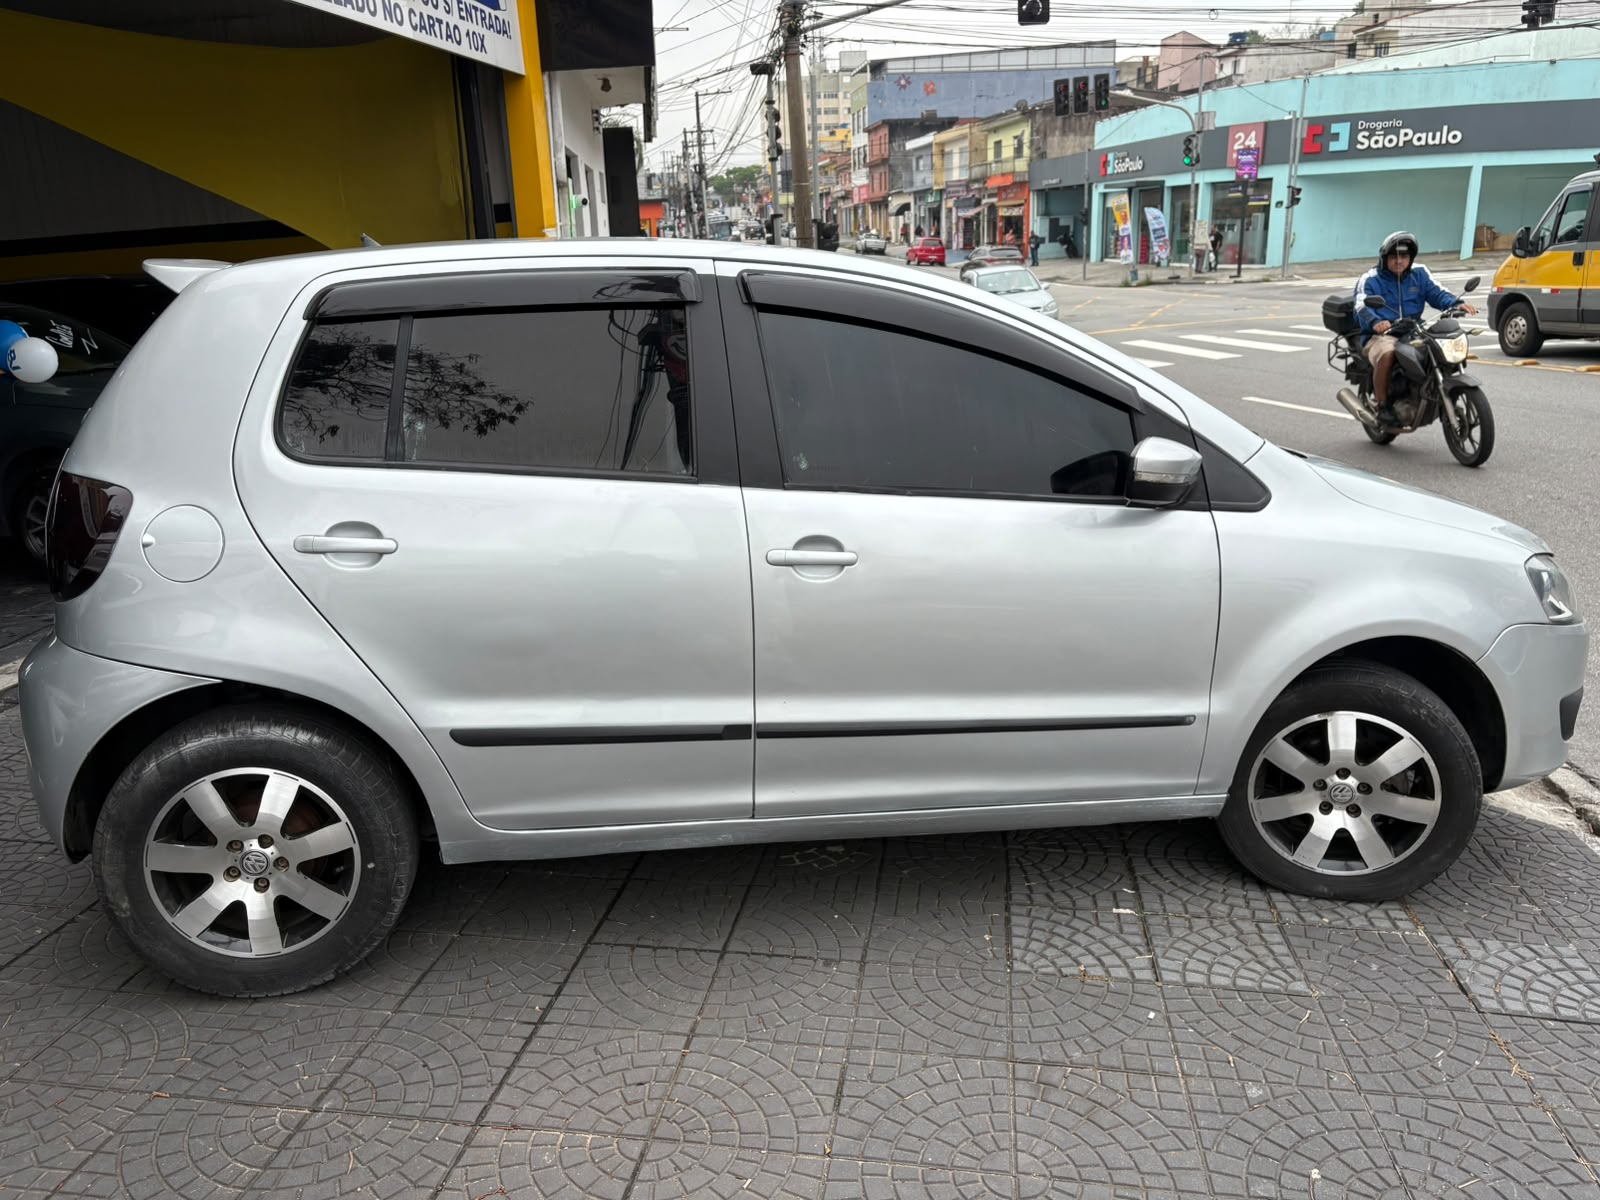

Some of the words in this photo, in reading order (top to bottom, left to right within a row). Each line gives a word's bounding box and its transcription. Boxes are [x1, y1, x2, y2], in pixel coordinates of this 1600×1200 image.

[381, 0, 404, 27] NO
[466, 29, 488, 54] 10X
[456, 0, 512, 40] ENTRADA!
[1358, 118, 1403, 131] Drogaria
[1233, 130, 1257, 150] 24
